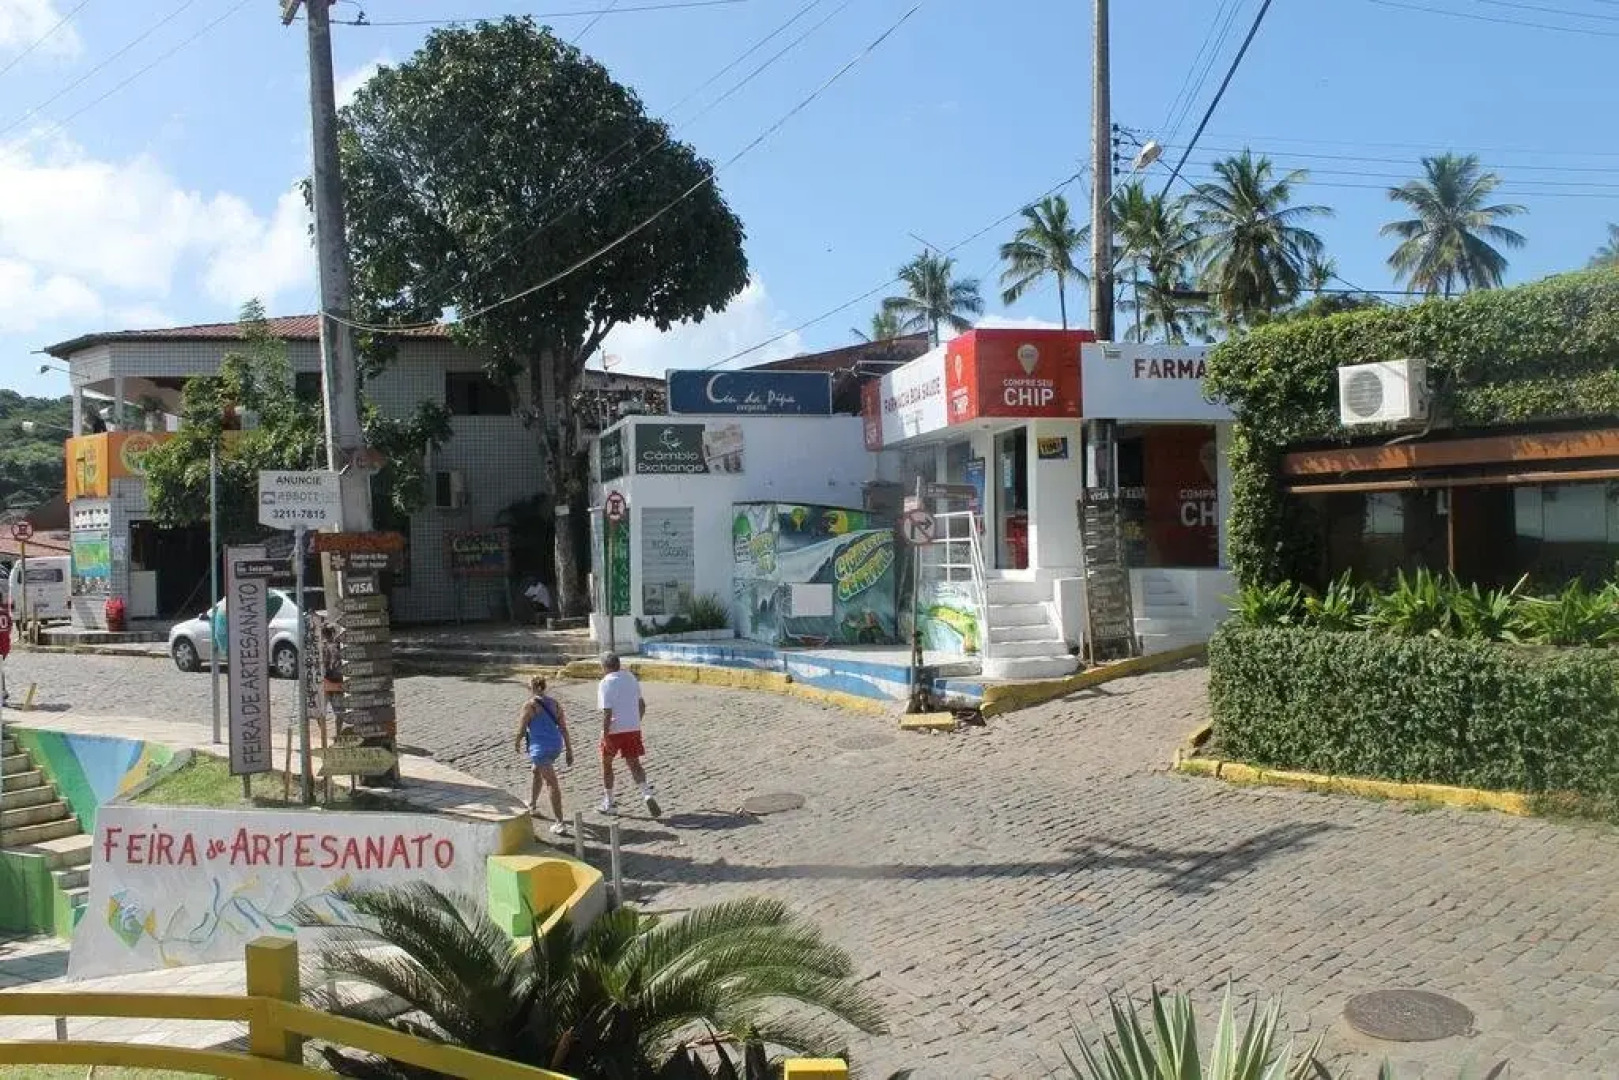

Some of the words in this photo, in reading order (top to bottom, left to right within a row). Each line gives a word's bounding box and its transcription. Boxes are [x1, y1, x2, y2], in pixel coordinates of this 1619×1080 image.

[1003, 379, 1035, 387] COMPRE
[1004, 388, 1054, 406] CHIP
[276, 475, 322, 485] ANUNCIE
[348, 583, 374, 594] VISA
[239, 583, 260, 689] ARTESANATO
[241, 694, 261, 716] DE
[242, 716, 262, 765] FEIRA
[104, 823, 197, 866] FEIRA
[205, 838, 228, 862] de
[230, 826, 455, 871] ARTESANATO
